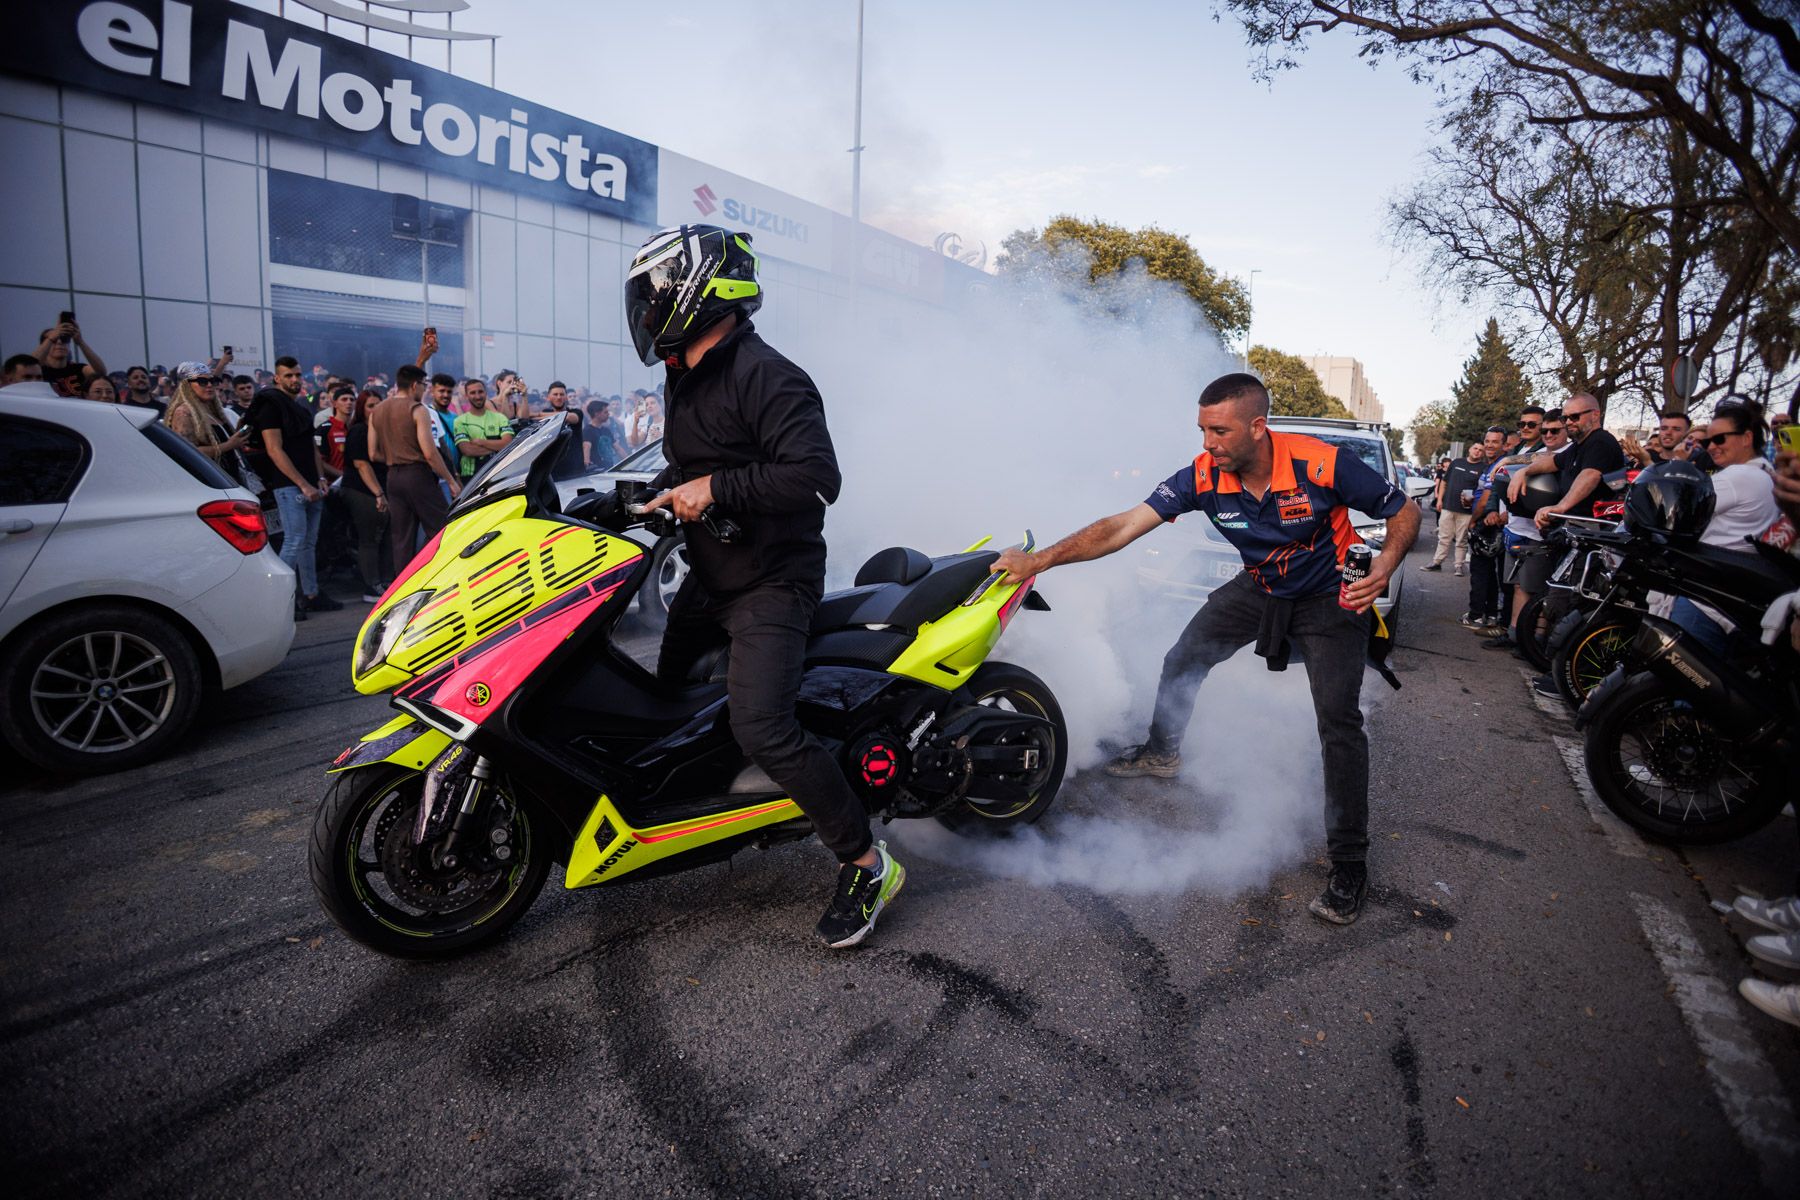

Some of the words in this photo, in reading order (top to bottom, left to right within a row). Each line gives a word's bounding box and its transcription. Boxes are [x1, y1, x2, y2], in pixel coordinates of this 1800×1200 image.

[77, 0, 192, 86] el
[221, 19, 627, 201] Motorista
[722, 198, 809, 243] SUZUKI
[680, 254, 713, 314] SCORPION
[594, 840, 638, 875] MOTUL
